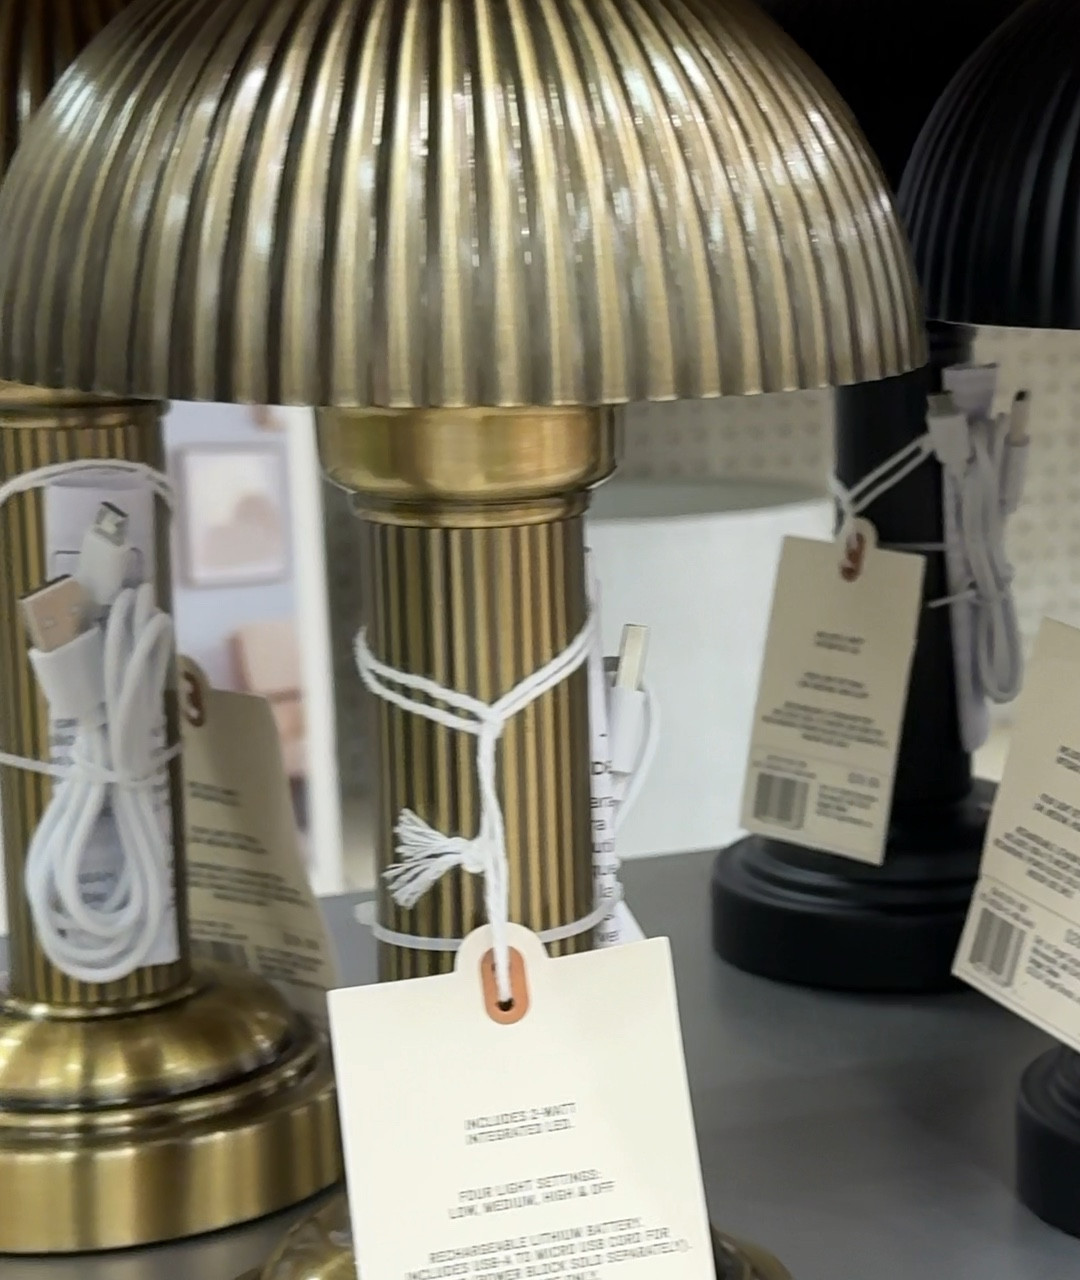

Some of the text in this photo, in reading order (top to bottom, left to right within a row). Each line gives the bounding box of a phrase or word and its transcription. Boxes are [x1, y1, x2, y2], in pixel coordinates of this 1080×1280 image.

[464, 1110, 526, 1131] INCLUDES
[465, 1123, 541, 1145] INTEGRATED
[458, 1186, 492, 1202] FOUR
[494, 1179, 533, 1197] LIGHT
[543, 1187, 574, 1203] HIGH
[589, 1180, 616, 1196] OFF
[428, 1235, 527, 1265] RECHARGEABLE
[531, 1228, 581, 1247] LITHIUM
[515, 1251, 532, 1264] TO
[536, 1243, 576, 1261] MICRO
[579, 1237, 605, 1253] USB
[608, 1230, 642, 1248] CORD
[645, 1226, 671, 1241] FOR
[525, 1260, 566, 1279] BLOCK
[570, 1253, 603, 1270] SOLD
